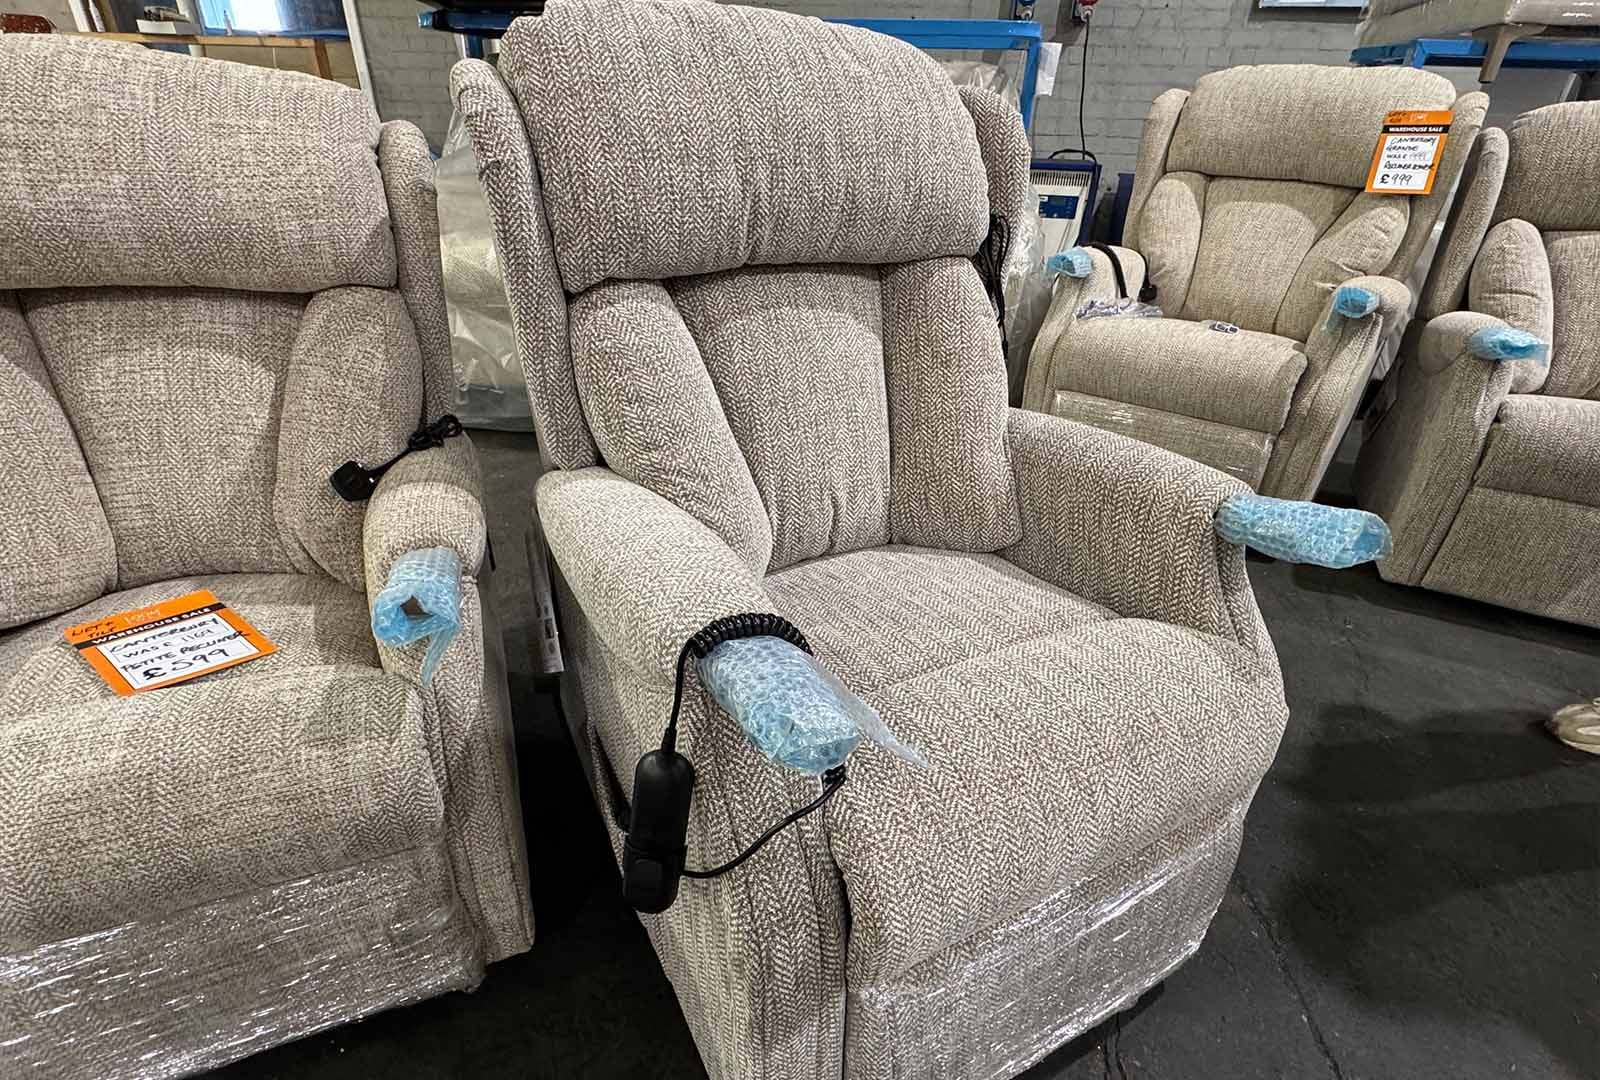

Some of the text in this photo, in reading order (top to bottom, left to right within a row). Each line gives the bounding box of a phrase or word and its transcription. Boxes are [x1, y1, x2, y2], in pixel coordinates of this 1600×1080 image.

[92, 616, 180, 644] WAREHOUSE
[181, 607, 212, 620] SALE
[110, 617, 219, 653] CANTERBURY
[120, 630, 250, 673] PETITE RECLINER
